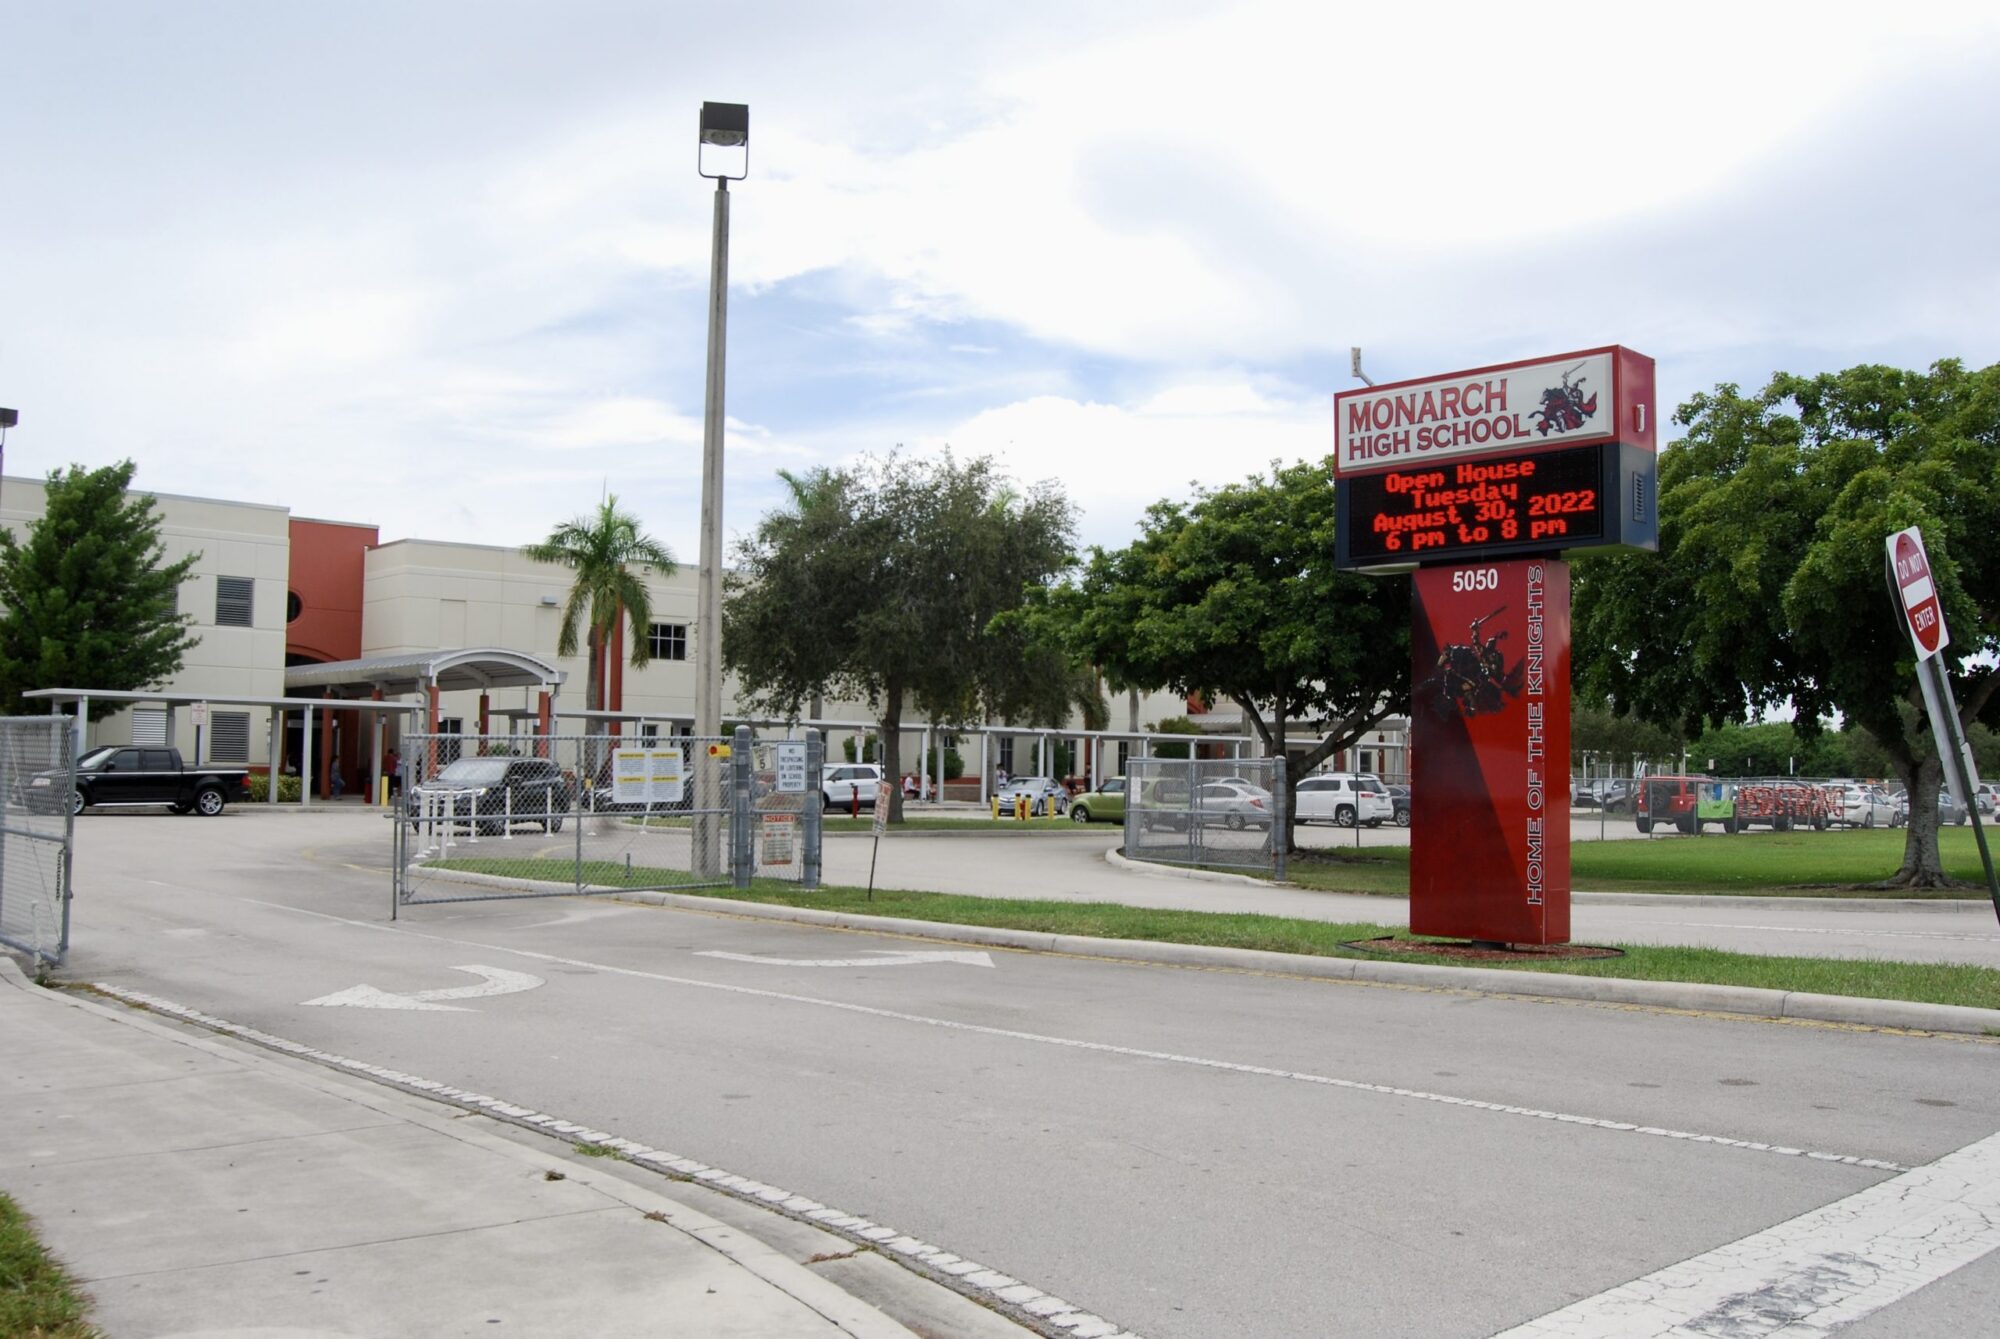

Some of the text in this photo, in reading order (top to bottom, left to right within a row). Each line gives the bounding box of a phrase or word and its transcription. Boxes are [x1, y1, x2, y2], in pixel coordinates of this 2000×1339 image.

[1348, 379, 1508, 434] MONARCH
[1348, 413, 1531, 461] HIGH SCHOOL
[1385, 460, 1535, 493] Open House
[1411, 482, 1518, 508] Tuesday
[1373, 490, 1595, 532] August 30, 2022
[1386, 518, 1567, 550] 6 pm to 8 pm
[1452, 568, 1499, 592] 5050
[1898, 552, 1923, 580] DO NOT
[1914, 606, 1936, 632] ENTER
[1527, 565, 1543, 905] HOME OF THE KNIGHTS
[760, 758, 766, 770] 5
[764, 814, 794, 822] NOTICE
